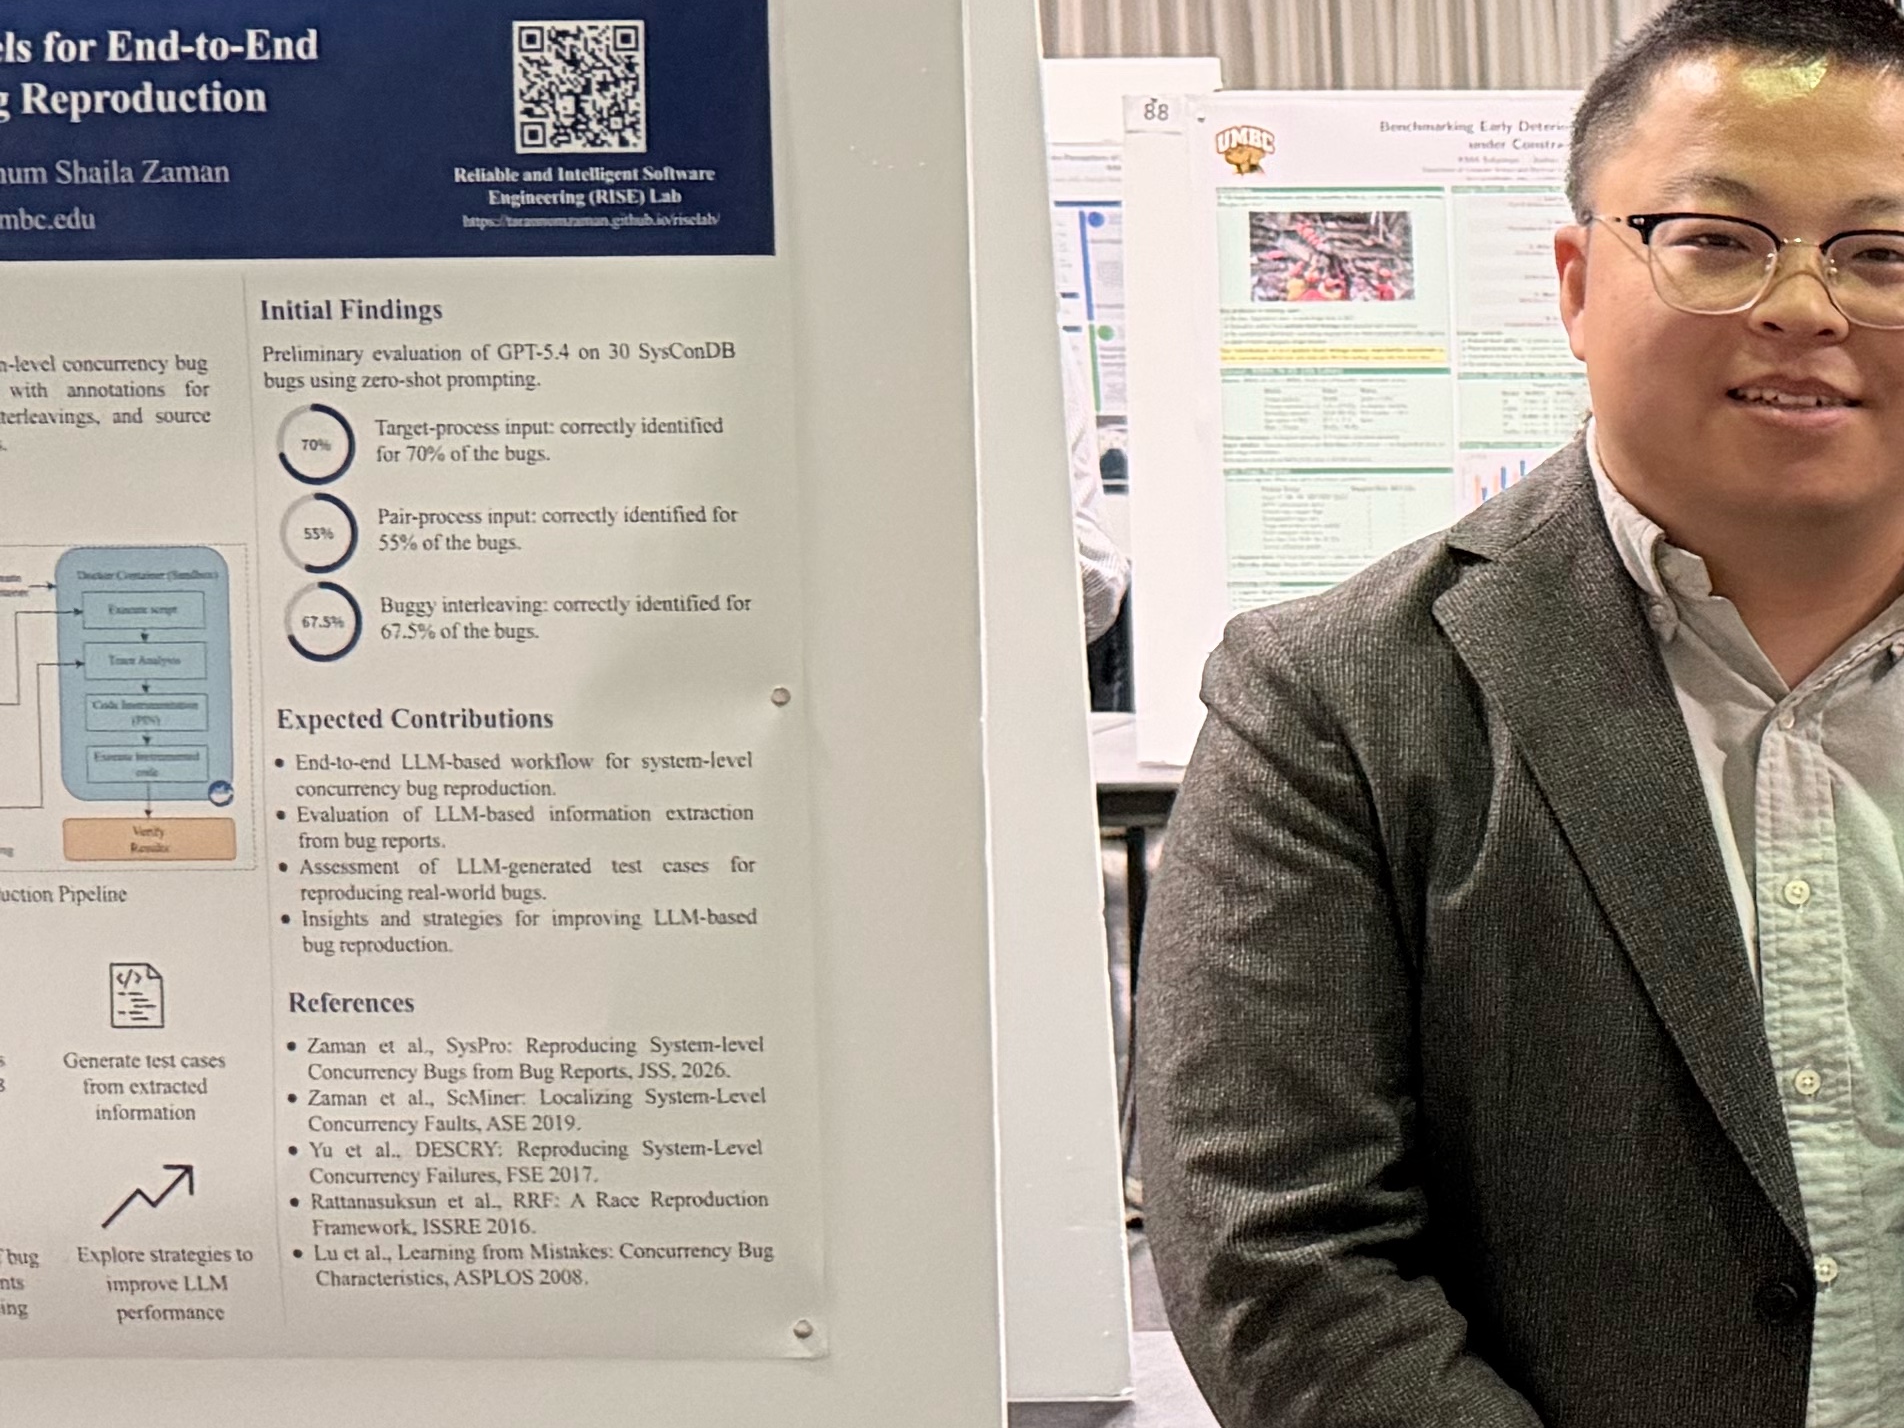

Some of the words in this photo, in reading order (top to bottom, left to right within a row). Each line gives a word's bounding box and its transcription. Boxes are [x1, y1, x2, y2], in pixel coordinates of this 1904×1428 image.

[0, 31, 31, 63] ls
[43, 31, 97, 62] for
[108, 28, 318, 62] End-to-End
[21, 80, 266, 122] Reproduction
[1144, 103, 1169, 121] 88
[1216, 126, 1275, 152] UMBC
[56, 158, 134, 184] Shaila
[142, 159, 229, 183] Zaman
[455, 167, 519, 182] Reliable
[523, 168, 553, 182] and
[558, 166, 639, 185] Intelligent
[643, 166, 714, 181] Software
[489, 189, 586, 208] Engineering
[589, 189, 645, 206] (RISE)
[650, 188, 682, 203] Lab
[0, 206, 96, 231] mbc.edu
[262, 300, 332, 321] Initial
[341, 299, 443, 325] Findings
[262, 345, 363, 367] Preliminary
[372, 344, 461, 362] evaluation
[470, 344, 491, 361] of
[497, 343, 569, 361] GPT-5.4
[578, 347, 599, 360] on
[609, 343, 629, 359] 30
[639, 342, 735, 364] SysConDB
[263, 371, 305, 393] bugs
[310, 372, 357, 393] using
[362, 371, 441, 388] zero-shot
[447, 371, 540, 392] prompting.
[375, 419, 500, 441] Target-process
[506, 418, 554, 439] input:
[560, 417, 636, 438] correctly
[642, 416, 724, 434] identified
[302, 438, 331, 451] 70%
[304, 527, 334, 541] 55%
[302, 615, 345, 628] 67.5%
[278, 709, 383, 735] Expected
[391, 707, 553, 729] Contributions
[295, 754, 390, 771] End-to-end
[401, 753, 500, 770] LLM-based
[510, 752, 594, 770] workflow
[605, 752, 631, 769] for
[641, 750, 752, 773] system-level
[296, 784, 400, 801] concurrency
[406, 779, 438, 800] bug
[443, 779, 556, 800] reproduction.
[290, 992, 414, 1013] References
[307, 1037, 365, 1053] Zaman
[378, 1041, 394, 1054] et
[407, 1037, 433, 1055] al.,
[446, 1037, 511, 1058] SysPro:
[526, 1036, 637, 1058] Reproducing
[650, 1035, 764, 1057] System-level
[63, 1051, 141, 1069] Generate
[146, 1055, 176, 1068] test
[181, 1056, 226, 1068] cases
[83, 1078, 124, 1095] from
[129, 1077, 207, 1094] extracted
[96, 1103, 195, 1121] information
